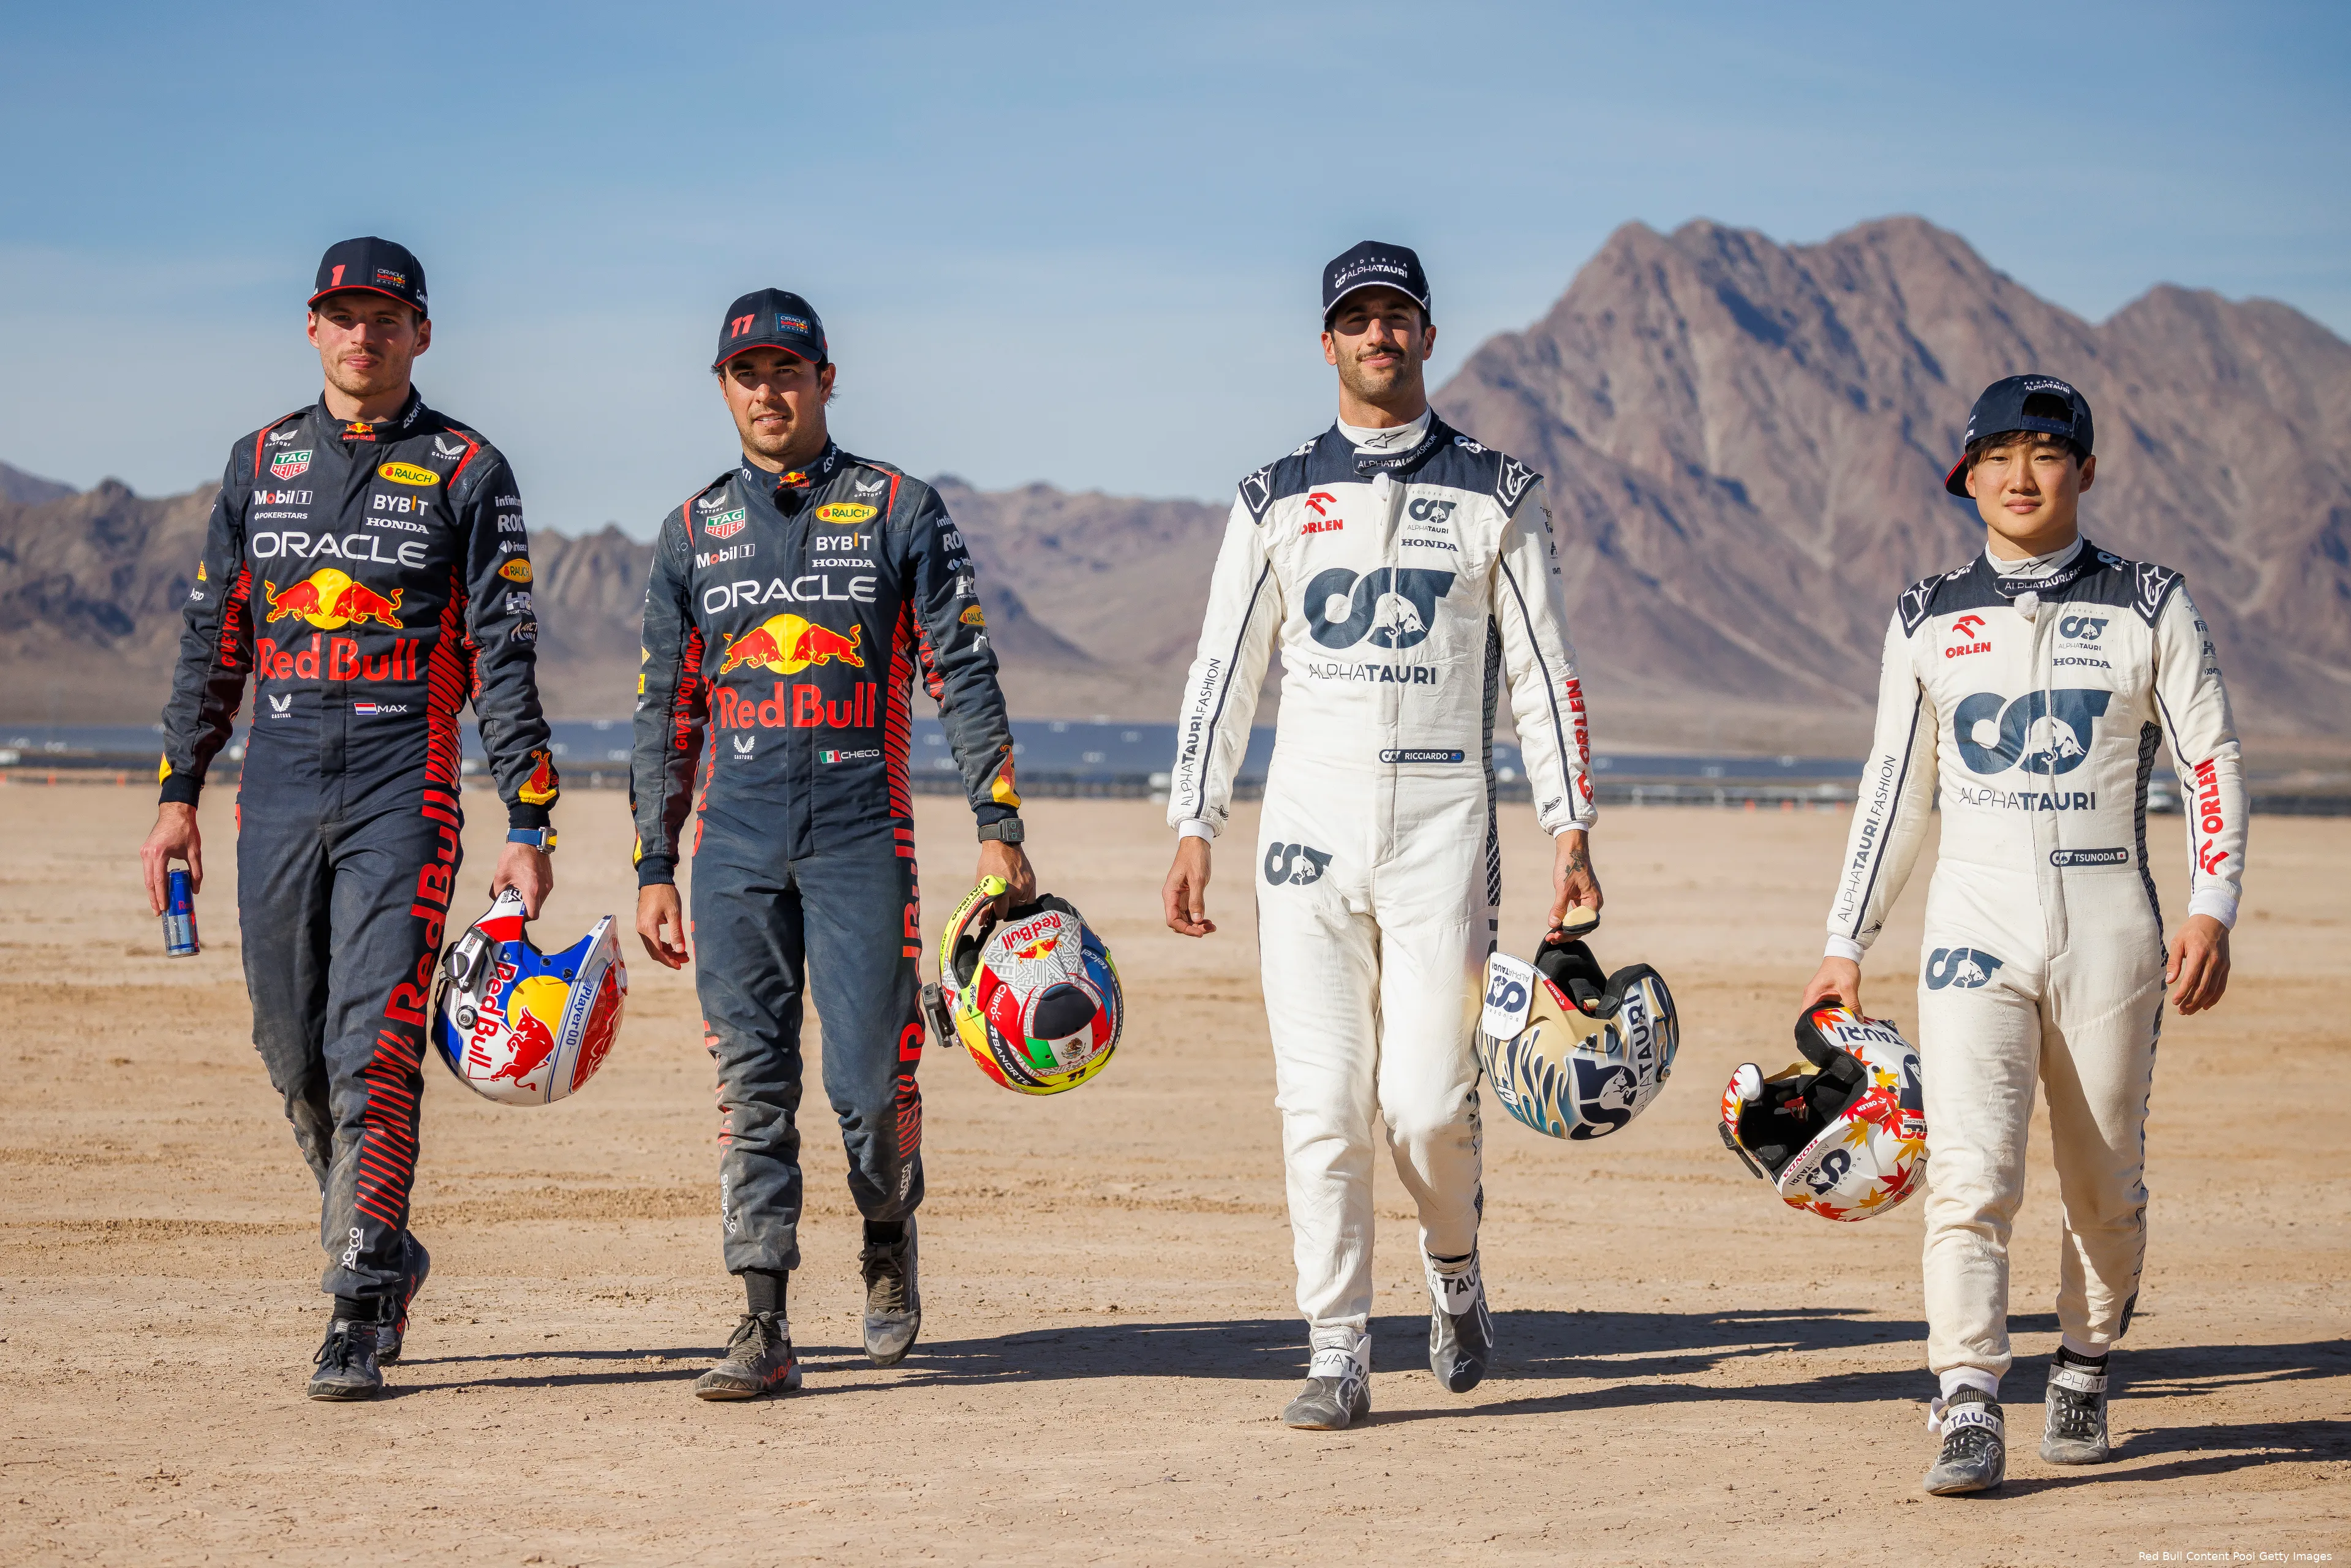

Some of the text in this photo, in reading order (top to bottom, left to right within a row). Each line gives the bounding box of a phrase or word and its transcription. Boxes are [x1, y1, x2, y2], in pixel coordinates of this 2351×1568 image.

[331, 264, 345, 286] 1
[377, 268, 406, 279] ORACLE
[1334, 257, 1407, 278] SCUDERIA
[1347, 265, 1408, 279] ALPHATAURI
[376, 279, 405, 289] RACING
[731, 314, 755, 338] 11
[780, 315, 807, 324] ORACLE
[781, 325, 809, 334] RACING
[2025, 383, 2070, 394] ALPHATAURI
[359, 433, 375, 442] Bull
[279, 453, 308, 464] TAG
[431, 451, 460, 461] CASTORE
[273, 464, 307, 478] HEUER
[394, 467, 432, 483] RAUCH
[254, 491, 295, 505] Mobil
[372, 494, 429, 516] BYBIT
[710, 511, 742, 526] TAG
[831, 508, 870, 518] RAUCH
[366, 517, 429, 534] HONDA
[707, 521, 744, 537] HEUER
[1406, 524, 1449, 534] ALPHATAURI
[252, 531, 429, 569] ORACLE
[816, 532, 872, 551] BYBIT
[1401, 539, 1459, 552] HONDA
[696, 546, 738, 568] Mobil
[812, 559, 876, 568] HONDA
[704, 575, 878, 614] ORACLE
[222, 600, 242, 631] YOU
[1945, 642, 1991, 659] ORLEN
[2058, 643, 2102, 651] ALPHATAURI
[256, 633, 419, 681] Red Bull
[2053, 657, 2112, 669] HONDA
[1308, 663, 1436, 685] ALPHATAURI
[676, 676, 698, 706] YOU
[377, 704, 407, 713] MAX
[715, 681, 877, 729] Red Bull
[675, 710, 692, 750] GIVES
[1565, 679, 1590, 766] ORLEN
[1180, 658, 1221, 807] ALPHATAURI.FASHION
[840, 749, 880, 760] CHECO
[1405, 752, 1449, 761] RICCIARDO
[1960, 787, 2096, 812] ALPHATAURI
[1838, 755, 1896, 922] ALPHATAURI.FASHION
[2074, 853, 2116, 862] TSUNODA
[383, 789, 461, 1027] Red Bull
[951, 881, 983, 921] JALISCO
[963, 888, 984, 912] inter.mx
[1033, 913, 1062, 936] Red
[1002, 929, 1030, 951] Bull
[1080, 948, 1108, 970] telcel
[1492, 962, 1530, 982] ALPHATAURI
[991, 984, 1007, 1014] Claro
[1547, 984, 1561, 998] ORLEN
[467, 962, 519, 1069] Red Bull
[572, 983, 593, 1030] Player
[1485, 1006, 1519, 1022] SCUDERI
[992, 1039, 1032, 1086] BANORTE
[1066, 1067, 1087, 1082] 11
[1856, 1100, 1877, 1112] ORLEN
[1783, 1138, 1819, 1178] HONDA
[1789, 1143, 1830, 1186] ALPHATAURI
